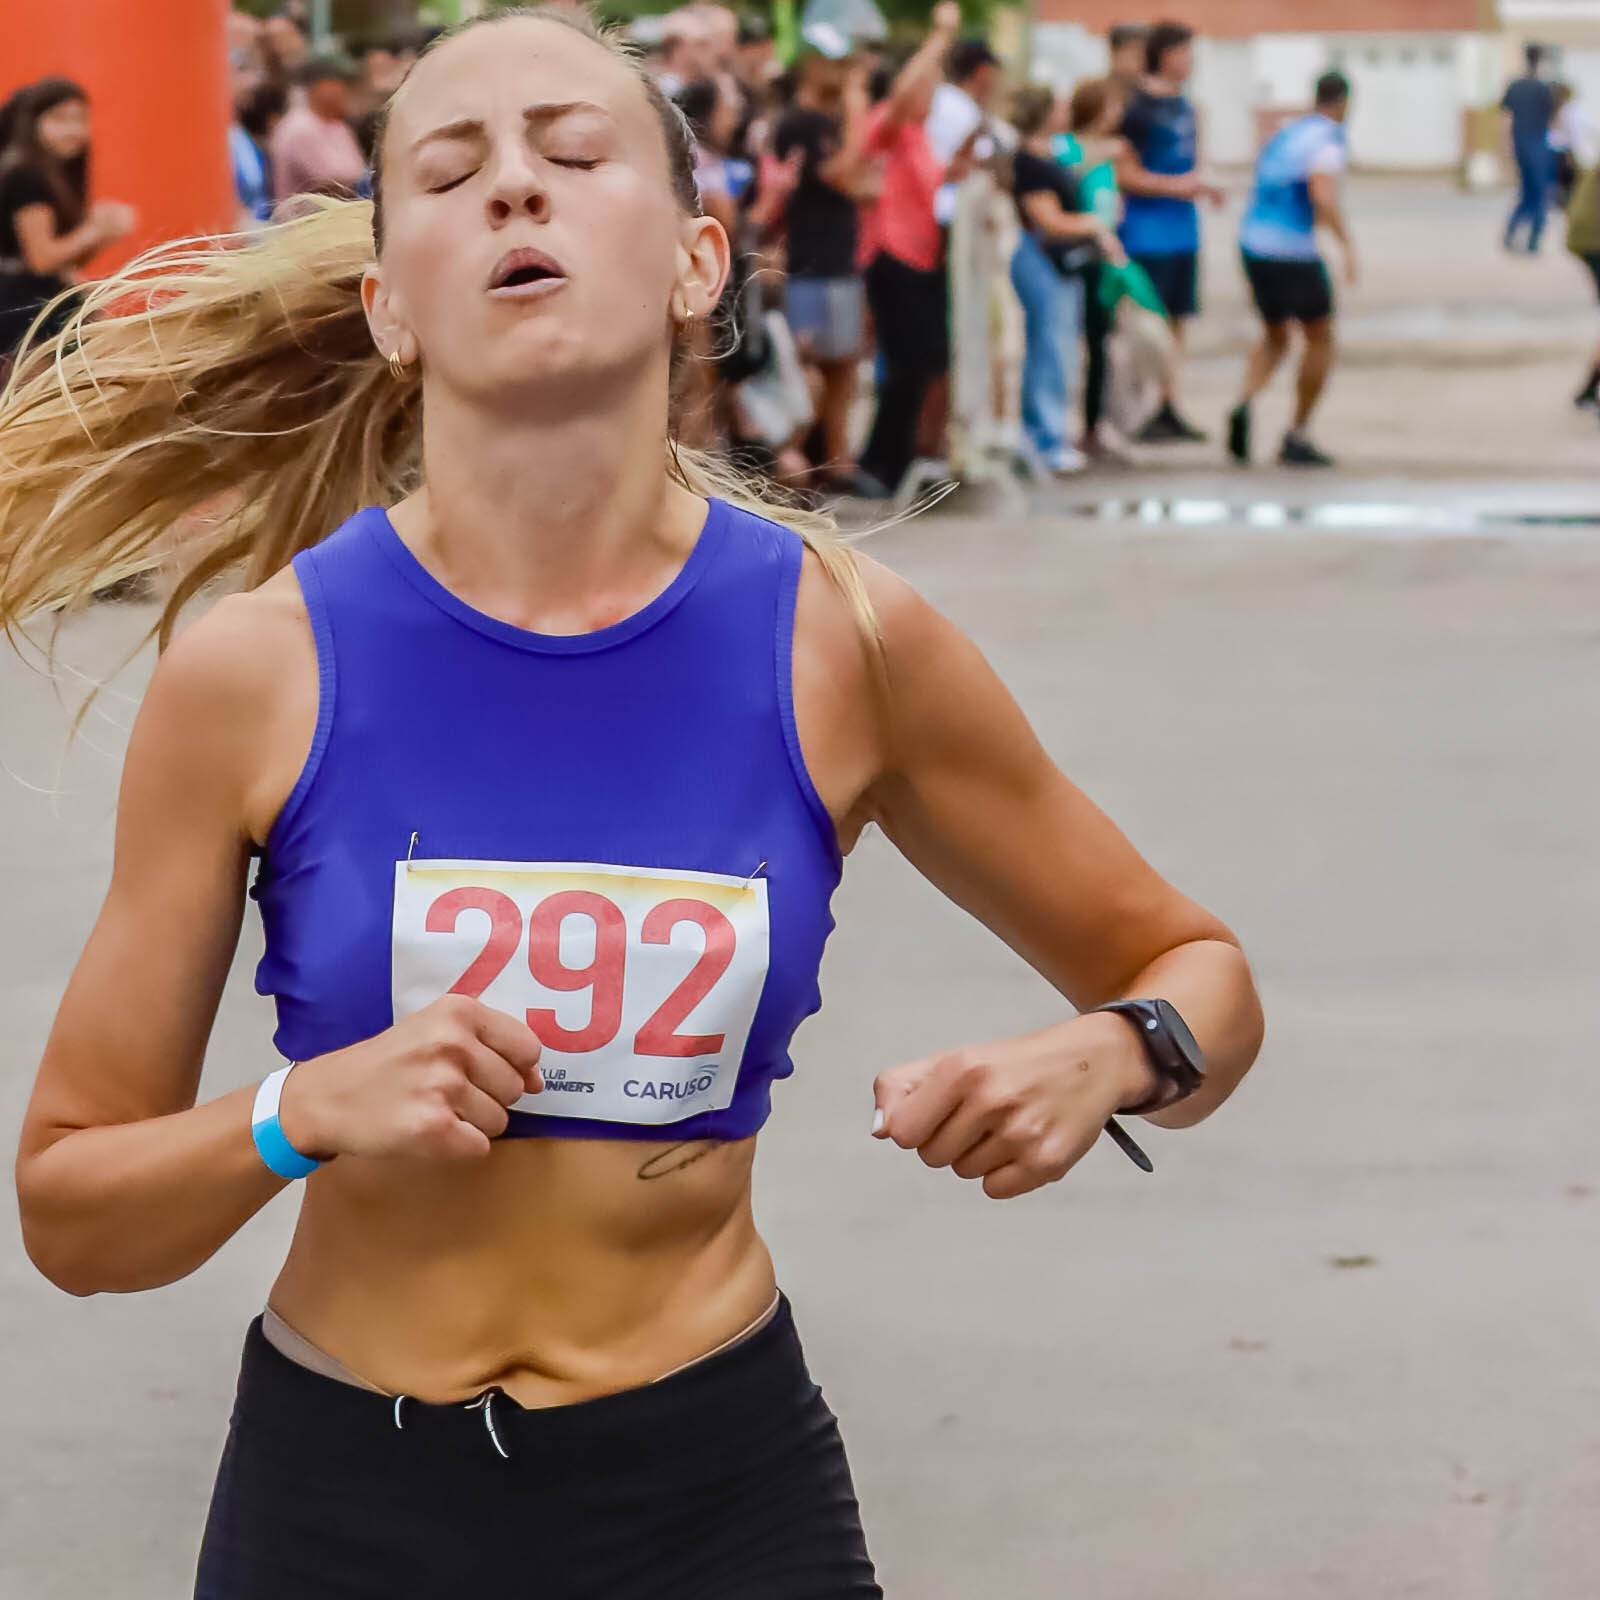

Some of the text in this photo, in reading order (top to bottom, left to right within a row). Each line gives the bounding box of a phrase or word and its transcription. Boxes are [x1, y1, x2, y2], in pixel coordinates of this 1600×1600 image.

[424, 886, 737, 1058] 292
[541, 1068, 567, 1080] LUB
[623, 1075, 713, 1100] CARUSO
